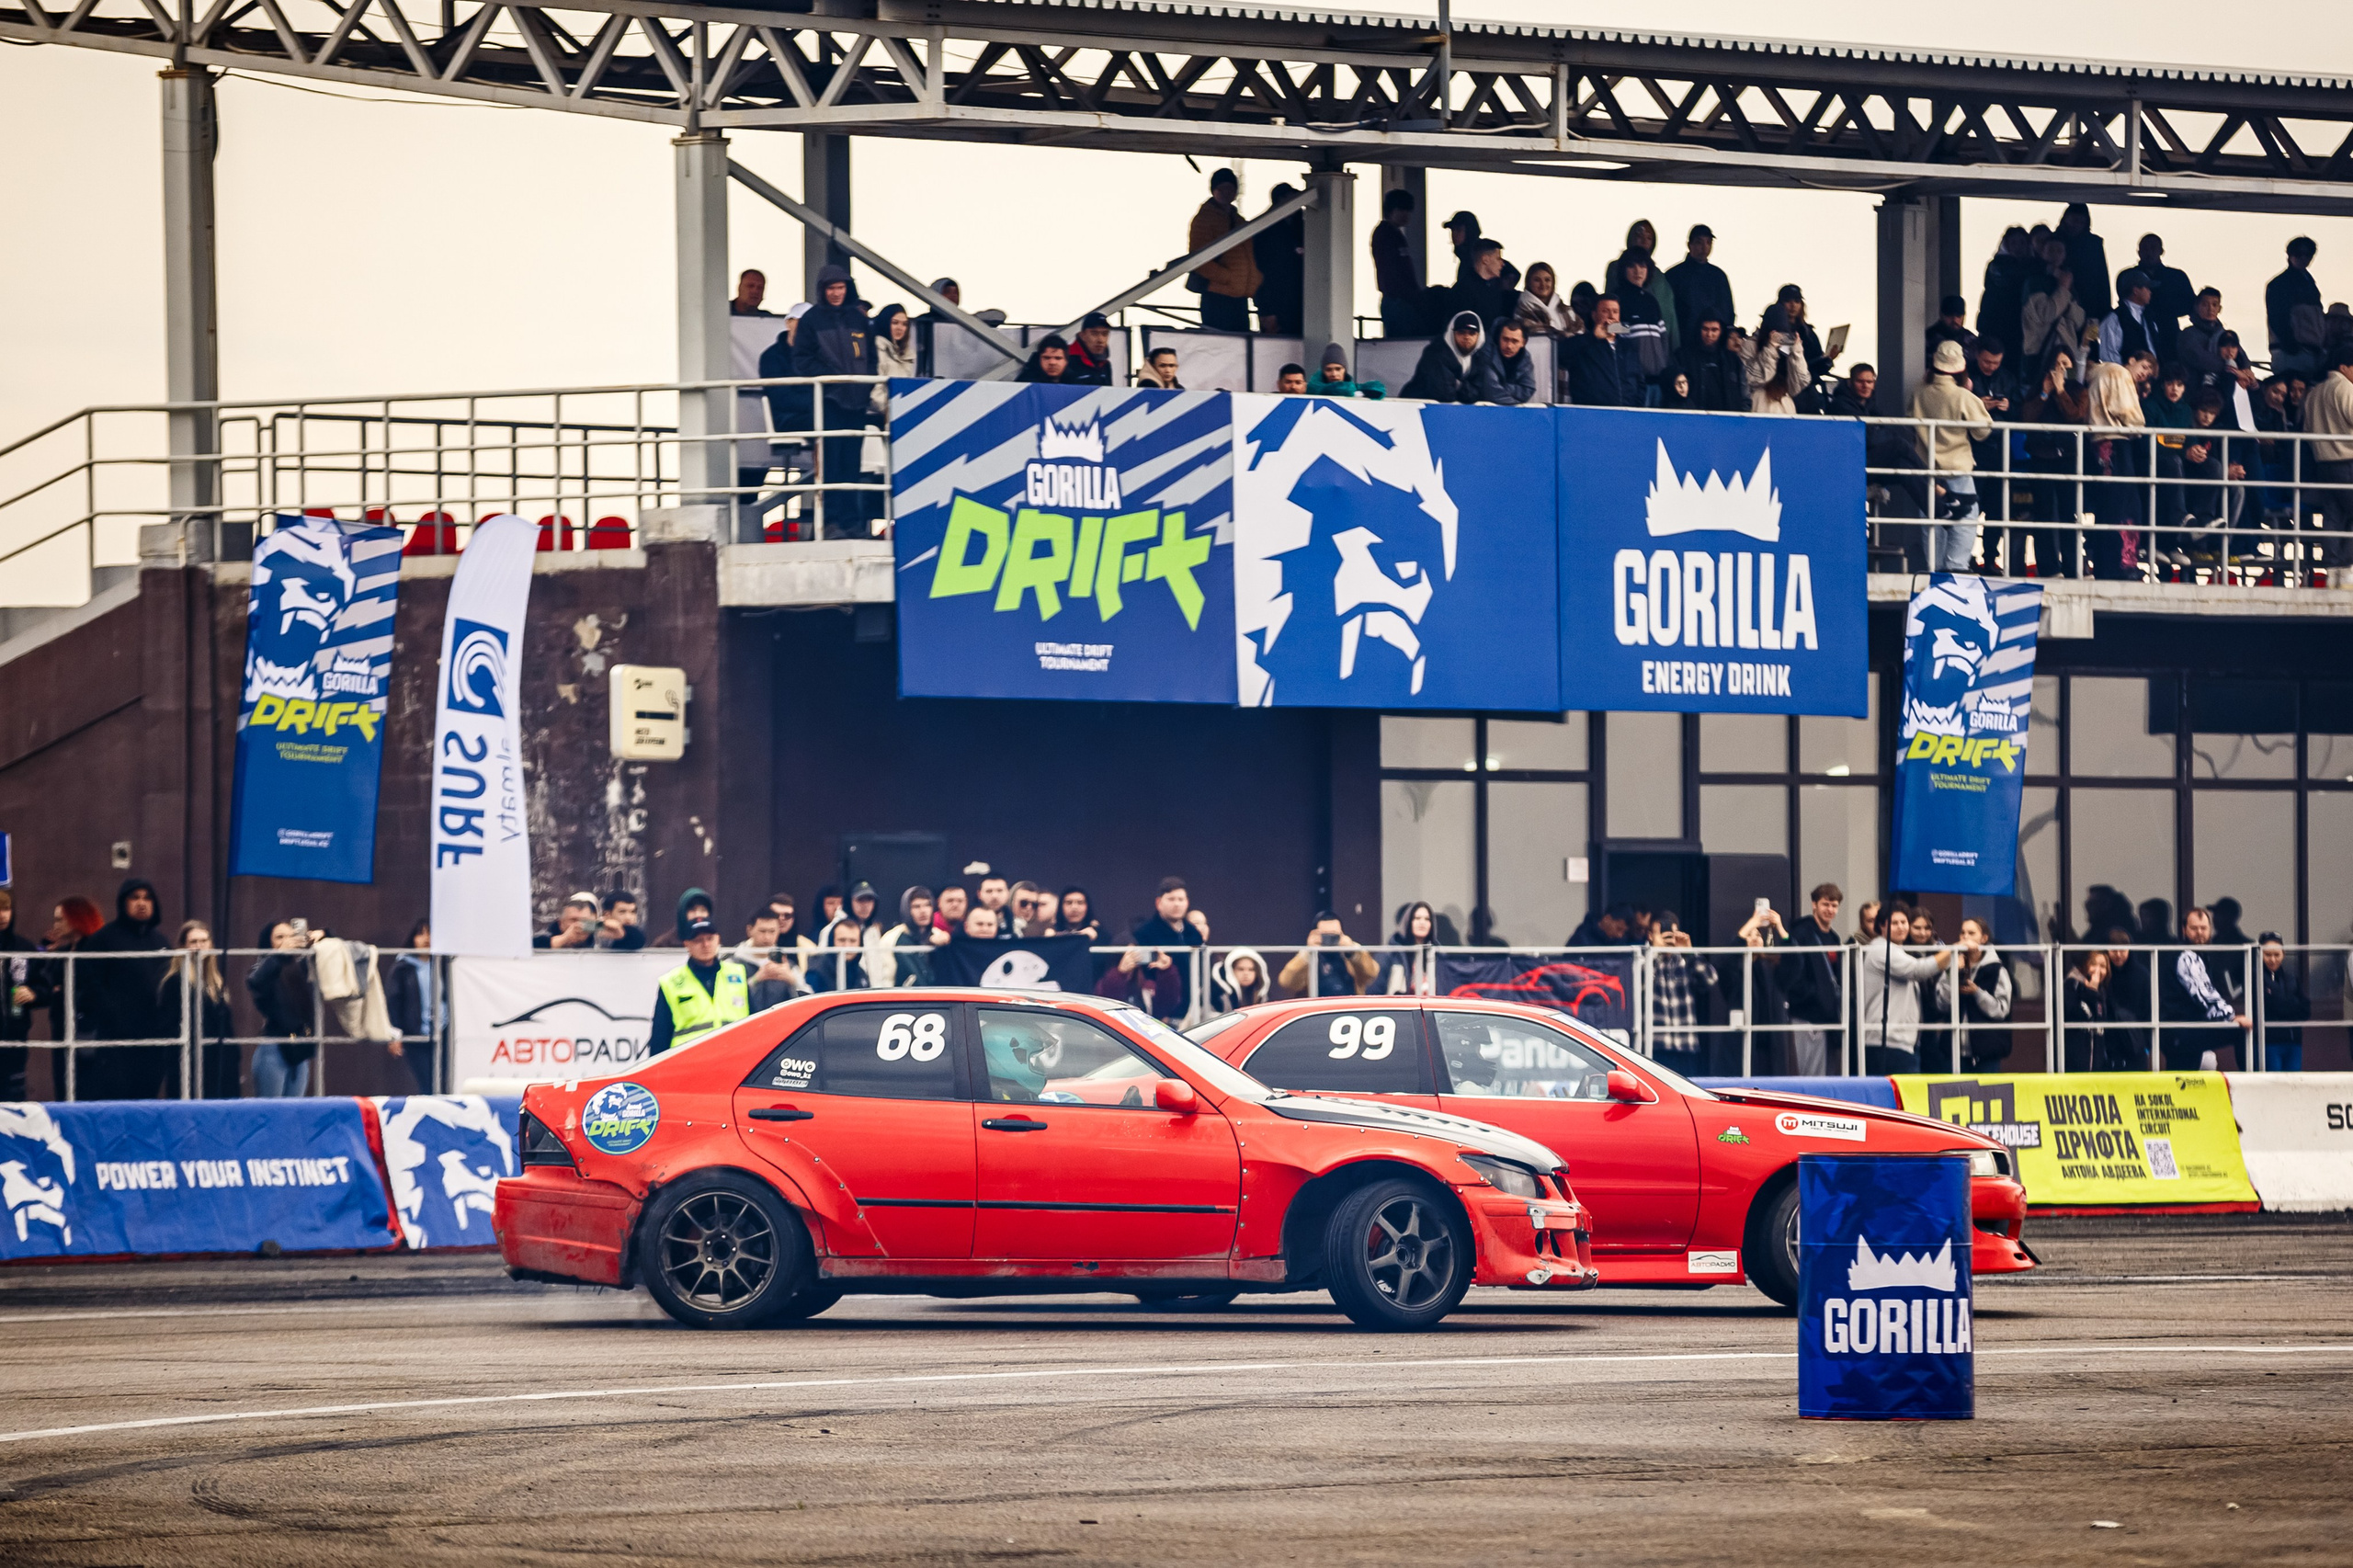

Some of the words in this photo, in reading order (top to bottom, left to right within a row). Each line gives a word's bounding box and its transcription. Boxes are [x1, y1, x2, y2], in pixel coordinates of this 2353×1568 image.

[1027, 463, 1121, 509] GORILLA
[929, 495, 1211, 631] DRIFT
[1614, 549, 1818, 650] GORILLA
[1035, 642, 1083, 656] ULTIMATE
[1084, 644, 1114, 658] DRIFT
[1039, 656, 1109, 672] TOURNAMENT
[323, 672, 378, 695] GORILLA
[1642, 661, 1723, 695] ENERGY
[1728, 662, 1791, 697] DRINK
[248, 692, 381, 743] DRIFT
[1970, 710, 2018, 732] GORILLA
[1906, 730, 2020, 774] DRIFT
[492, 1038, 650, 1064] АВТОРАДИ
[876, 1013, 946, 1062] 68
[1328, 1016, 1396, 1061] 99
[2044, 1094, 2122, 1125] ШКОЛА
[2137, 1108, 2200, 1120] INTERNATIONAL
[2148, 1094, 2175, 1107] SOKOL
[588, 1119, 652, 1138] DRIFT
[1802, 1119, 1858, 1131] MITSUJI
[2140, 1123, 2171, 1135] CIRCUIT
[2054, 1131, 2140, 1160] ДРИФТА
[96, 1162, 177, 1190] POWER
[181, 1160, 244, 1188] YOUR
[245, 1156, 349, 1187] INSTINCT
[2062, 1165, 2099, 1178] АНТОНА
[2101, 1165, 2146, 1180] АВДЕЕВА
[1824, 1298, 1973, 1354] GORILLA
